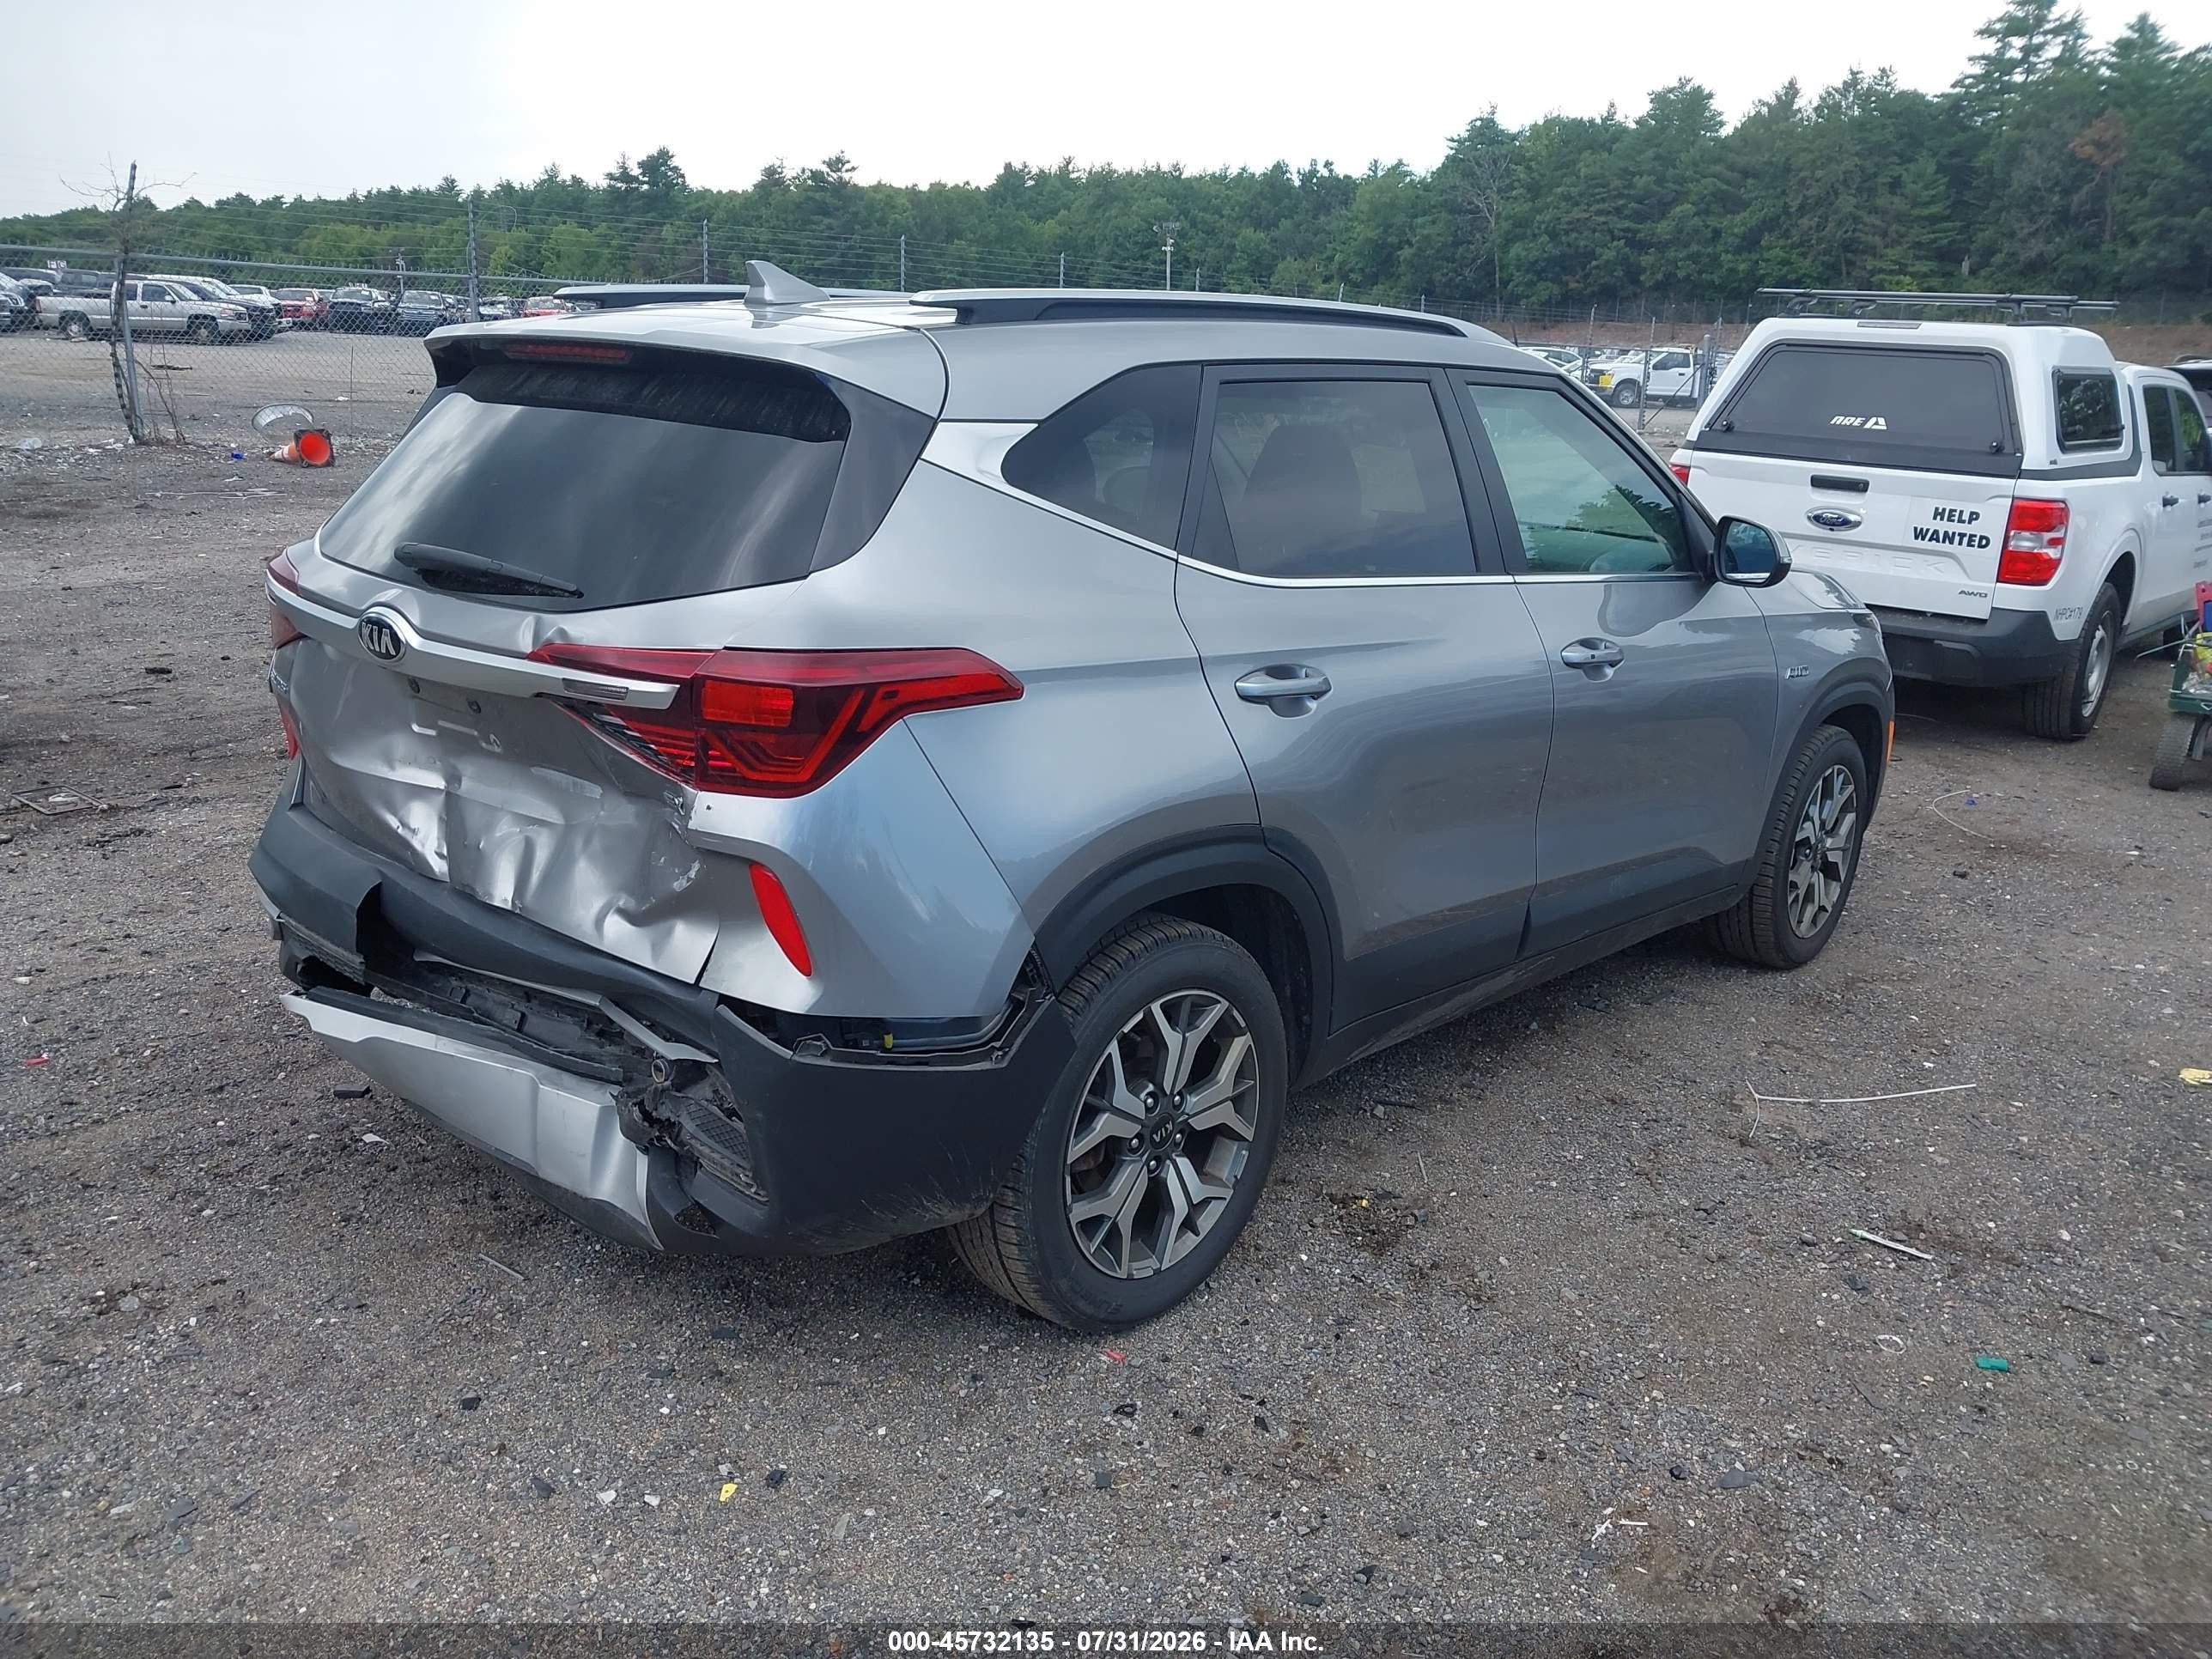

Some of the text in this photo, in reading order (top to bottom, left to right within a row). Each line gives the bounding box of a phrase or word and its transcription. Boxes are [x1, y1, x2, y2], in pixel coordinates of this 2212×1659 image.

[1932, 506, 1981, 525] HELP
[1912, 526, 1991, 550] WANTED
[1958, 589, 1989, 599] AWD
[361, 621, 397, 656] KIA
[1152, 1120, 1174, 1143] KIA
